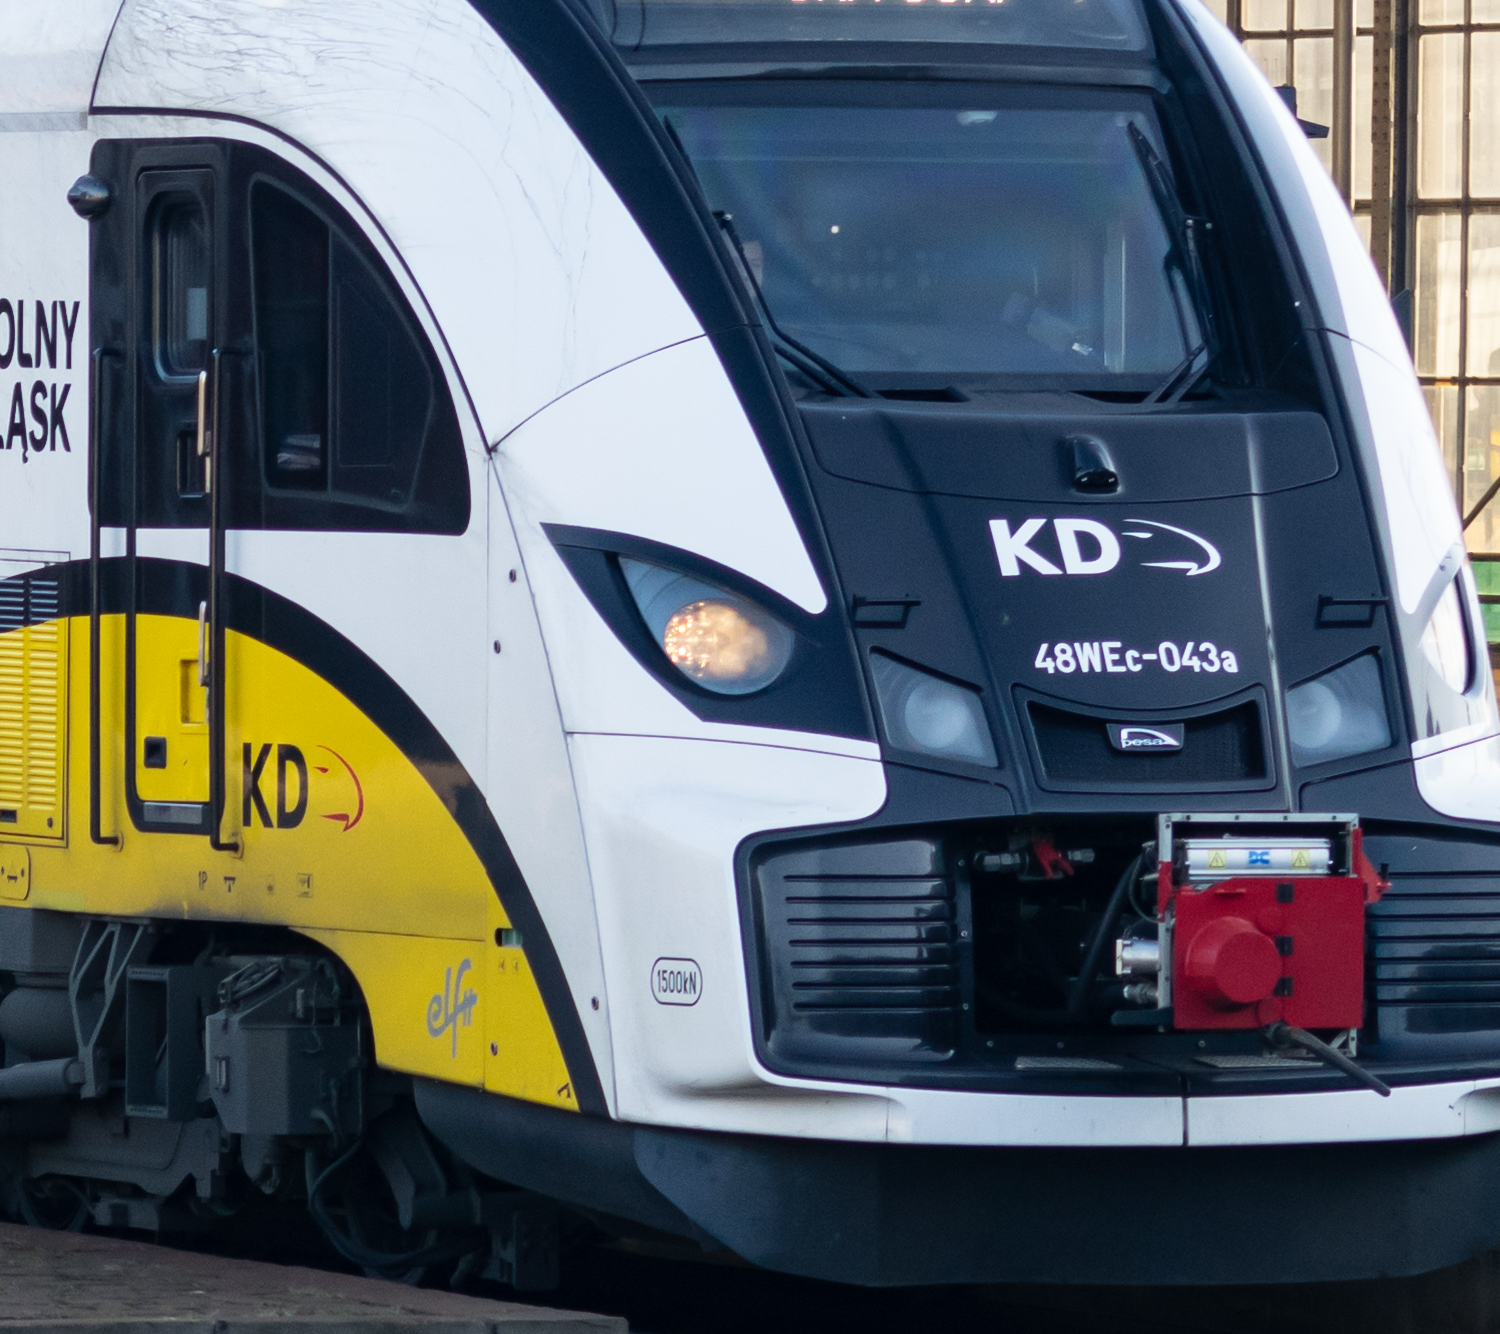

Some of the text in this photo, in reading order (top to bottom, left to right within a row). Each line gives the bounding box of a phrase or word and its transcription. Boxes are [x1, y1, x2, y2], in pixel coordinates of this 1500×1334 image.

[988, 518, 1121, 577] KD
[1034, 640, 1239, 674] 48WEc-043a
[242, 742, 309, 830] KD
[656, 968, 698, 996] 1500kN
